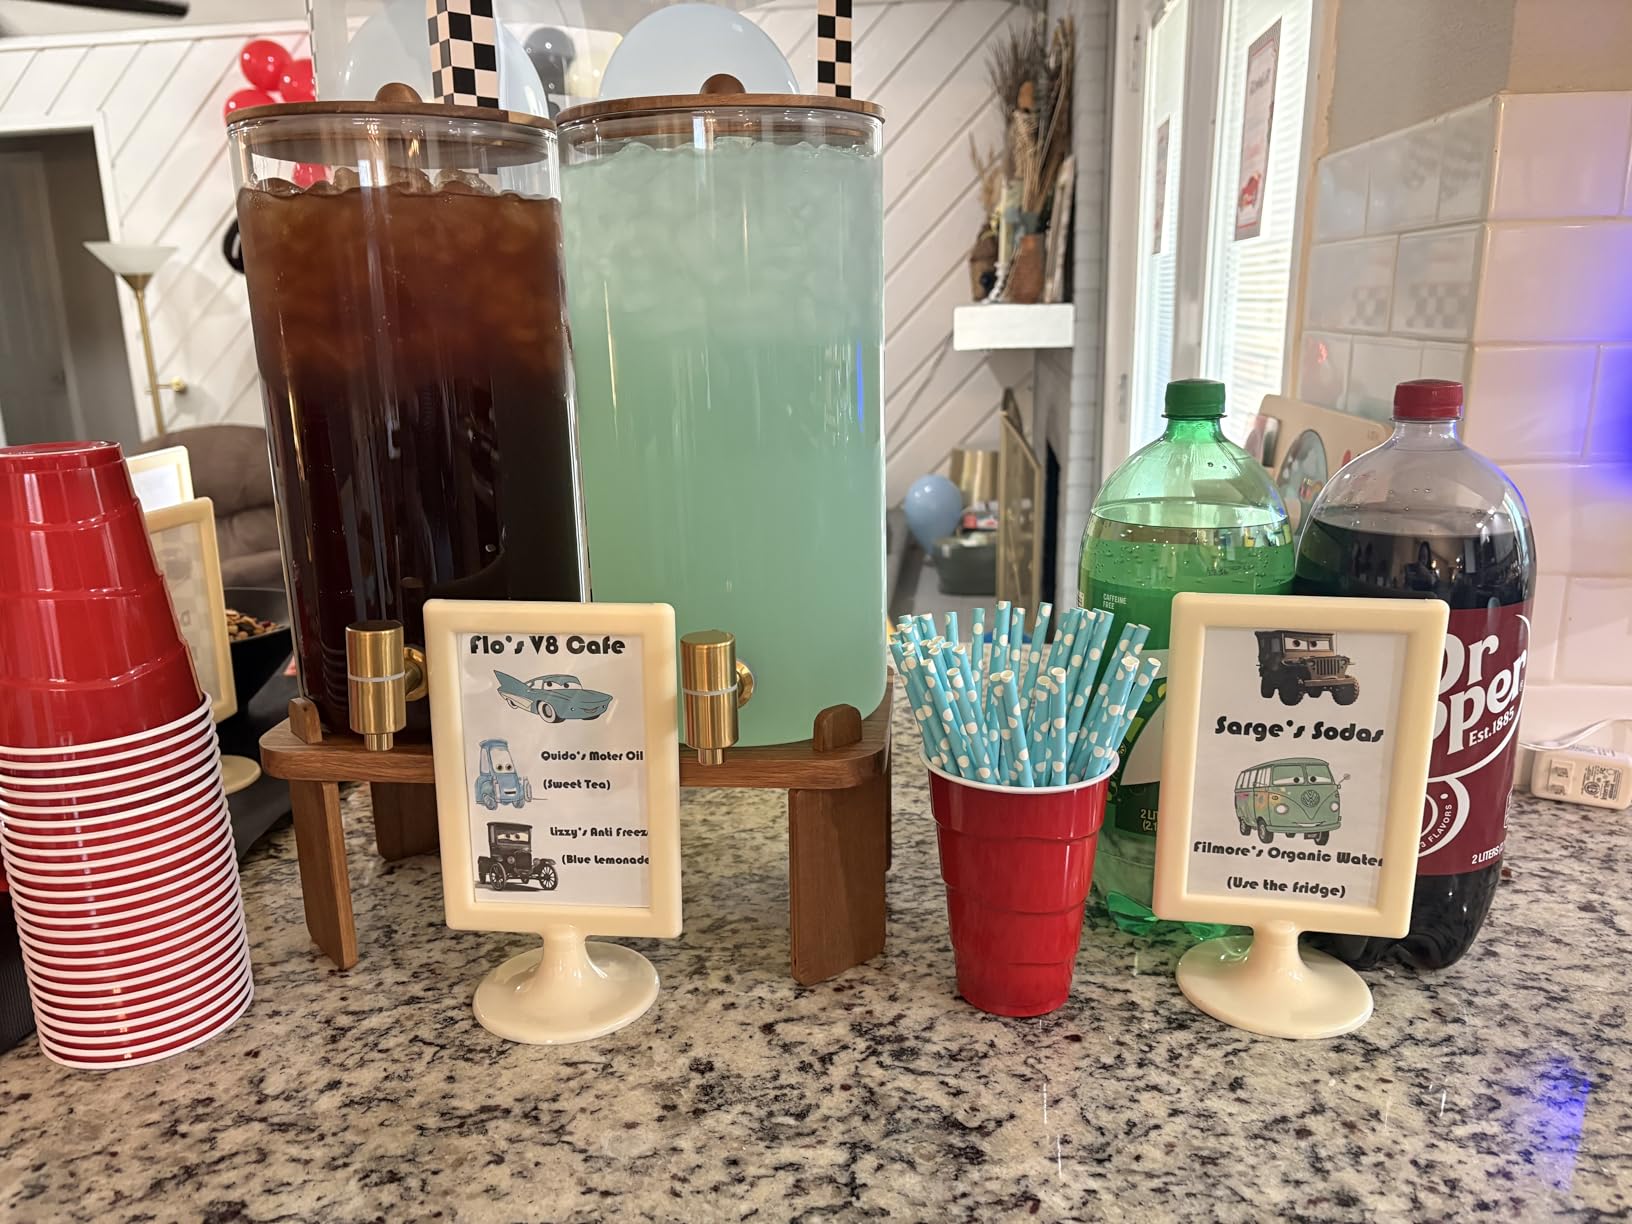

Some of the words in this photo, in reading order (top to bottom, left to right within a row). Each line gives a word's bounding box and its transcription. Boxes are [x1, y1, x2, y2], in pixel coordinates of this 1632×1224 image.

[1102, 593, 1127, 605] CAFFEINE
[1102, 600, 1115, 610] FREE
[469, 635, 525, 655] Flo's
[528, 635, 559, 655] V8
[565, 635, 626, 655] Cafe
[1214, 715, 1306, 742] Sarge's
[1311, 721, 1384, 743] Sodas
[589, 751, 624, 761] Moter
[626, 750, 644, 761] Oil
[543, 779, 582, 790] (Sweet
[584, 779, 611, 791] Tea)
[1140, 808, 1147, 819] 2
[1427, 803, 1453, 843] FLAVORS
[550, 827, 588, 839] Lizzy's
[590, 827, 613, 837] Anti
[616, 827, 649, 837] Freez
[561, 854, 592, 865] (Blue
[1193, 841, 1264, 858] Filmore's
[1267, 846, 1332, 863] Organic
[1336, 851, 1384, 867] Water
[1471, 854, 1478, 865] 2
[1226, 876, 1259, 890] (Use
[1263, 879, 1288, 892] the
[1292, 882, 1346, 899] fridge)
